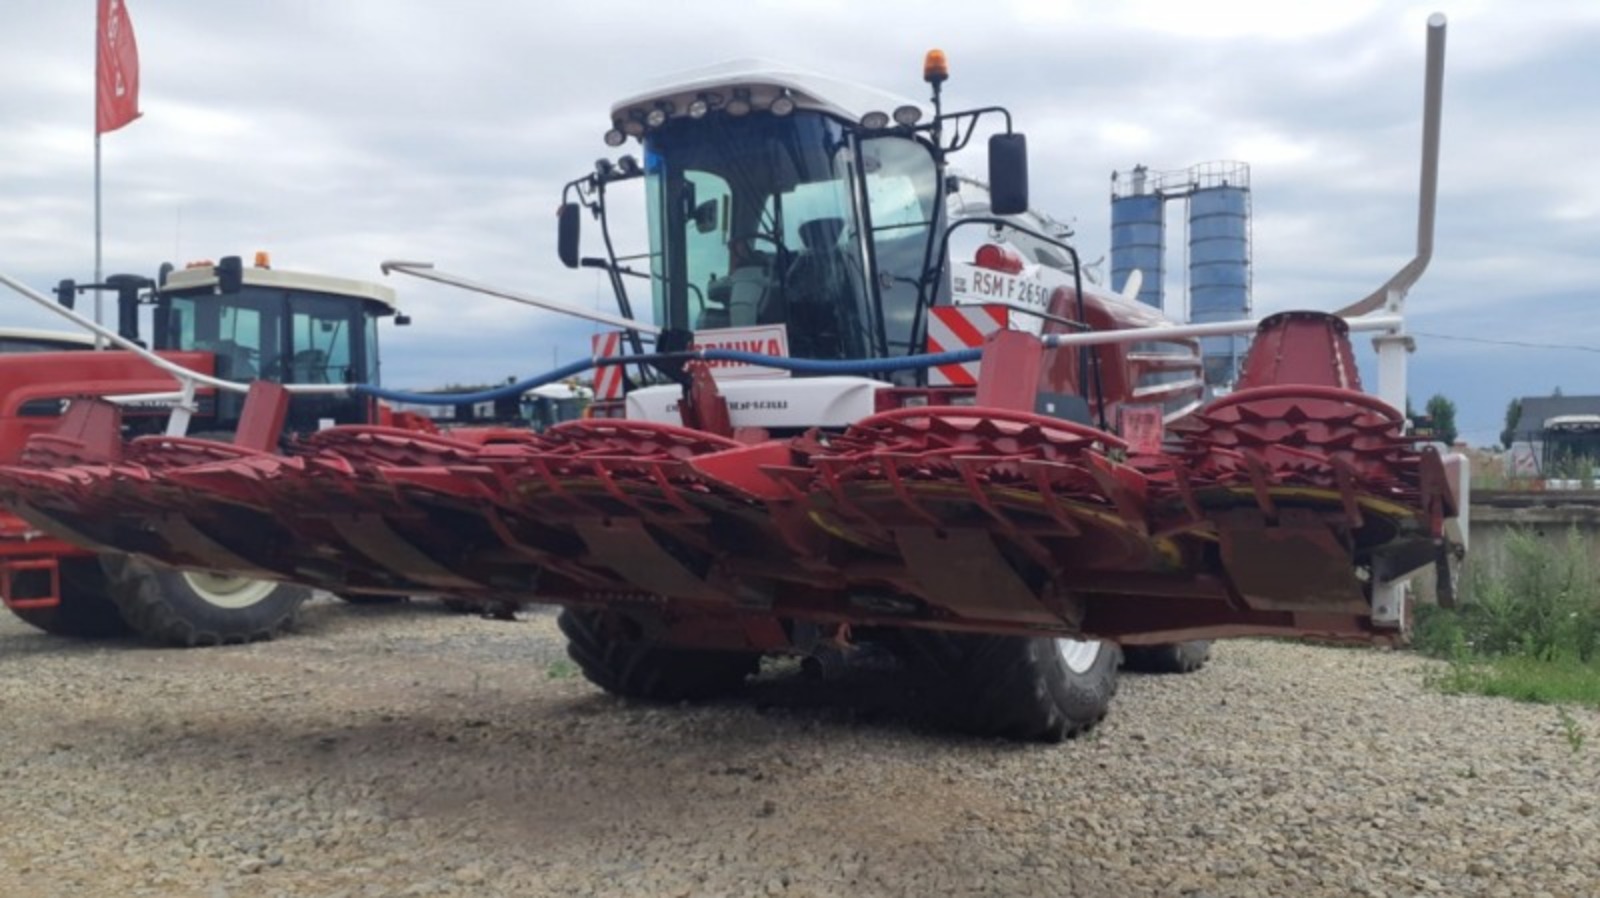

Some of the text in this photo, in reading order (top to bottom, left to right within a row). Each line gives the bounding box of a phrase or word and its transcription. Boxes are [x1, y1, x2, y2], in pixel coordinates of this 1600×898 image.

[973, 271, 1003, 297] RSM
[1007, 279, 1016, 299] F
[1018, 281, 1049, 307] 2650
